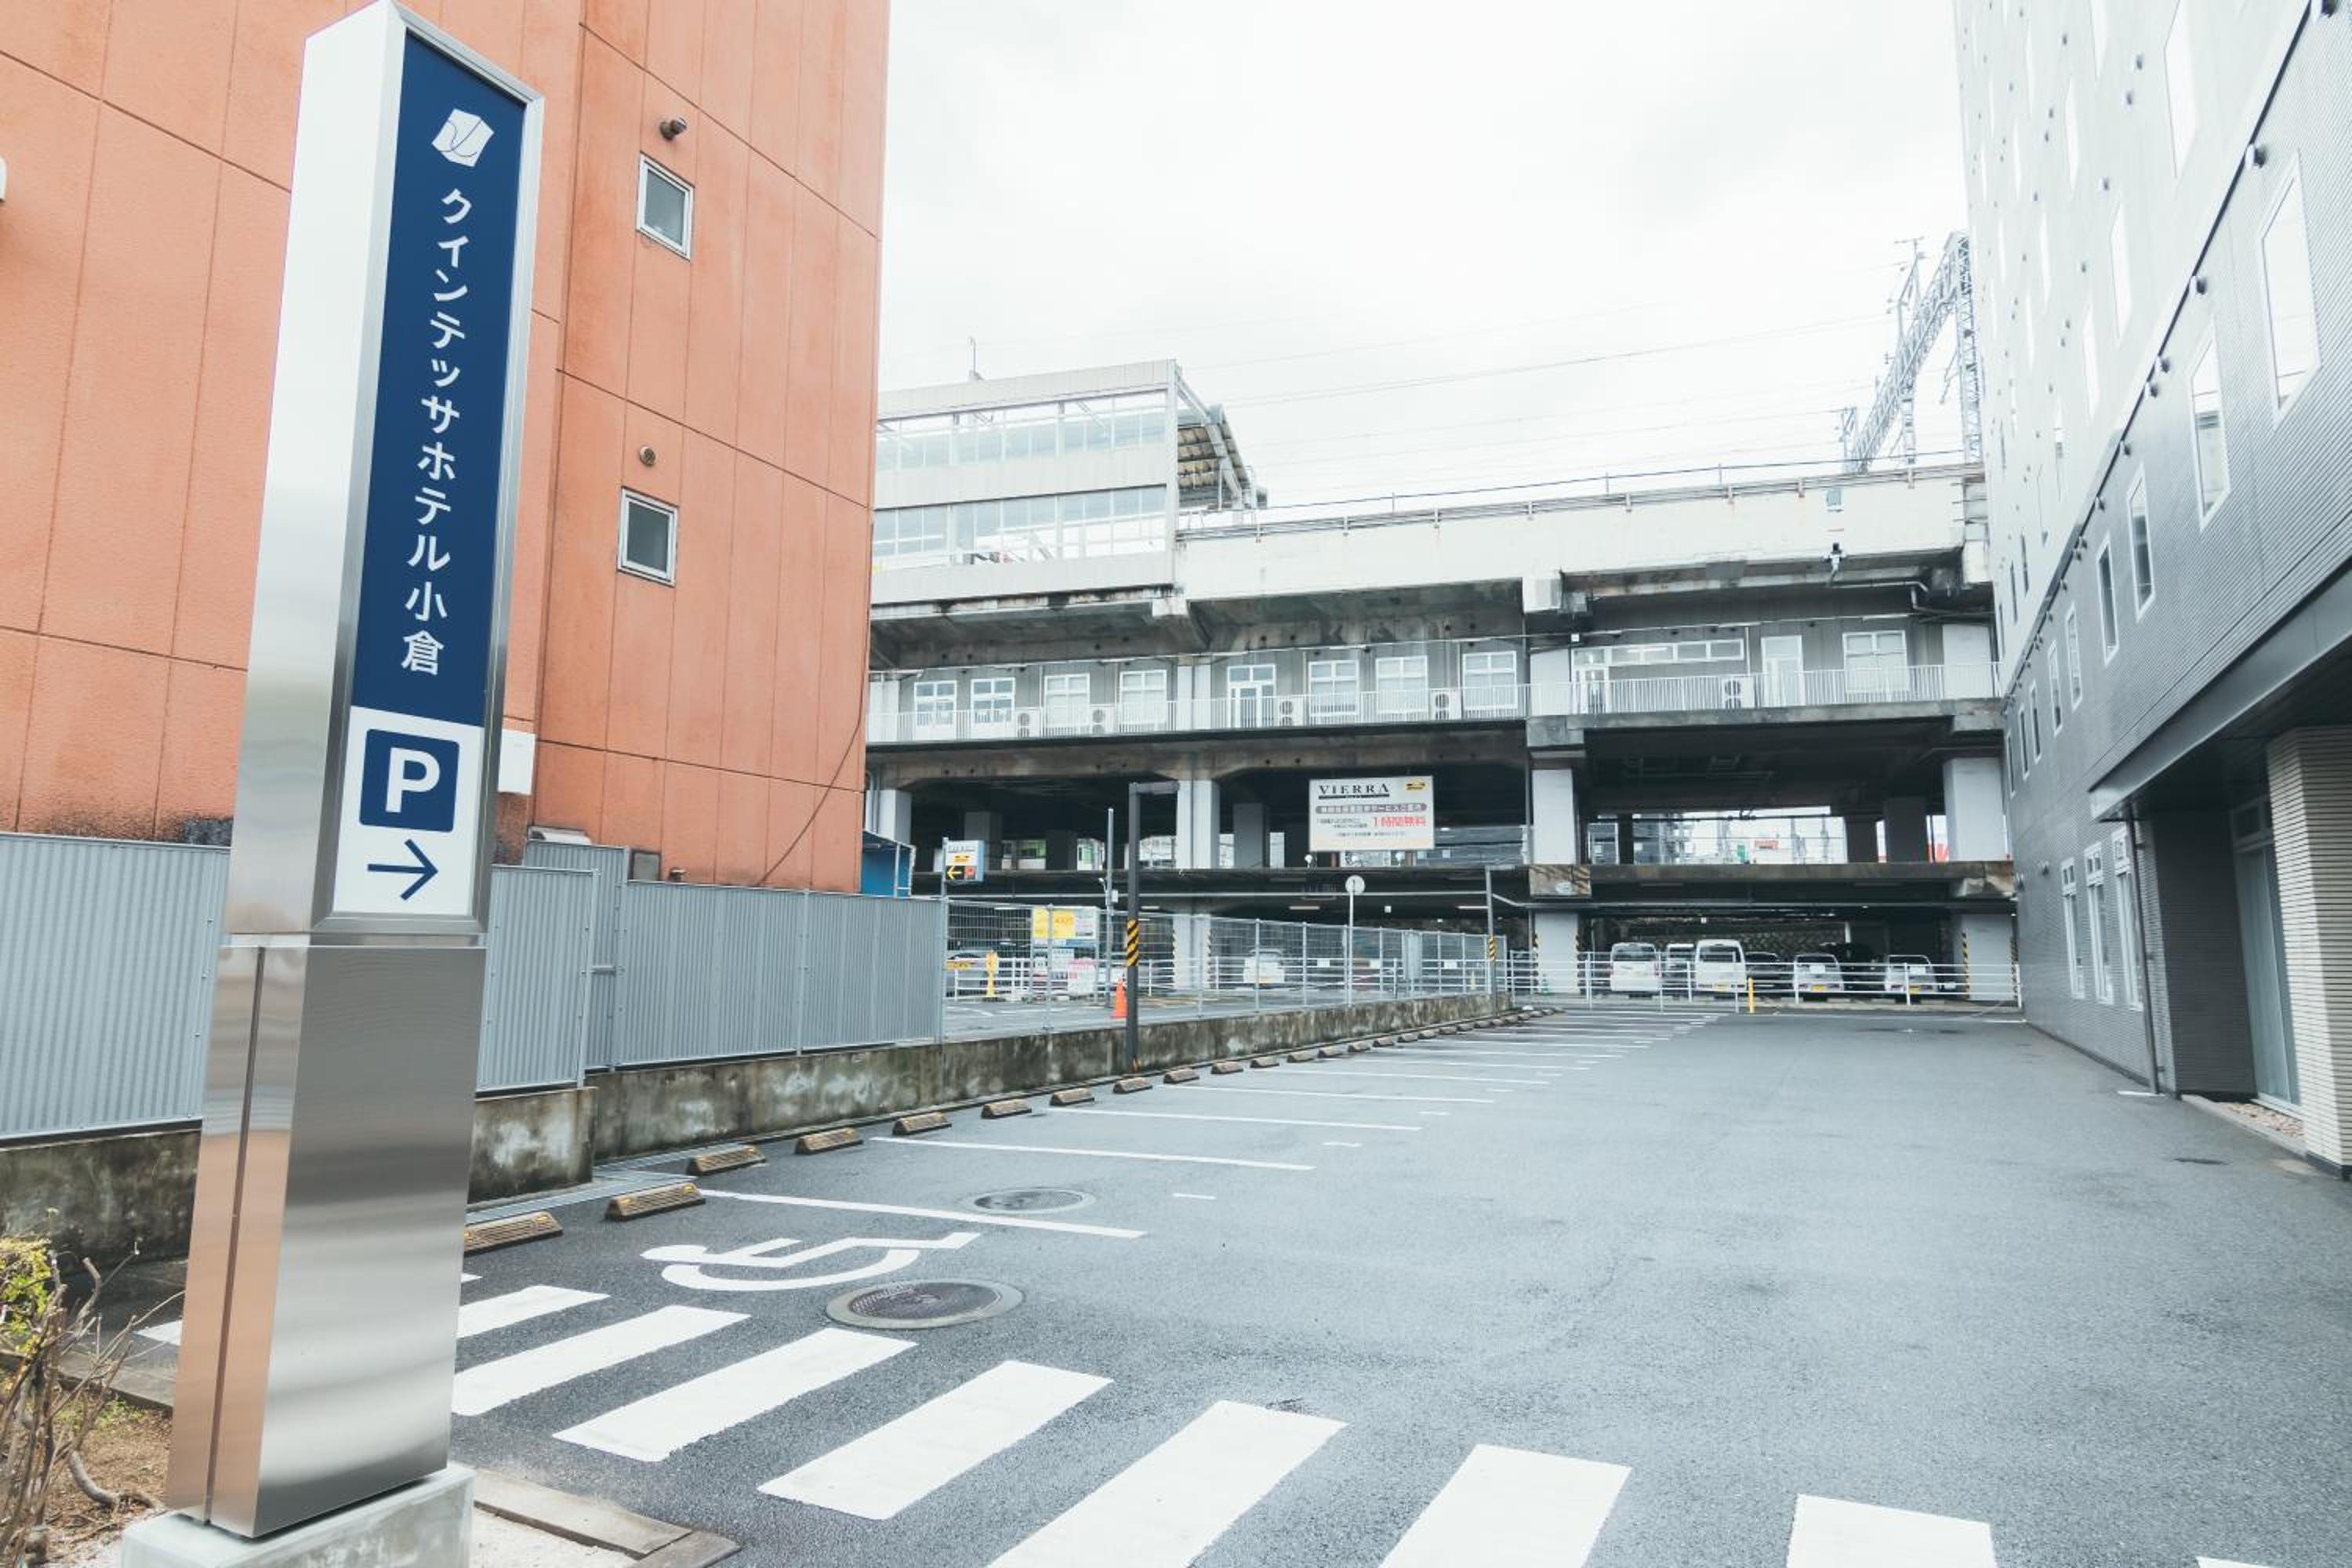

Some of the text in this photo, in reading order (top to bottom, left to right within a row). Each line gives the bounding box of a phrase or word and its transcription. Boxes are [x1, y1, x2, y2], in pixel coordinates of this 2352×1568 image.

[401, 189, 471, 675] クインテッサホテル小倉
[386, 747, 440, 813] P
[1319, 782, 1390, 794] VIERRA
